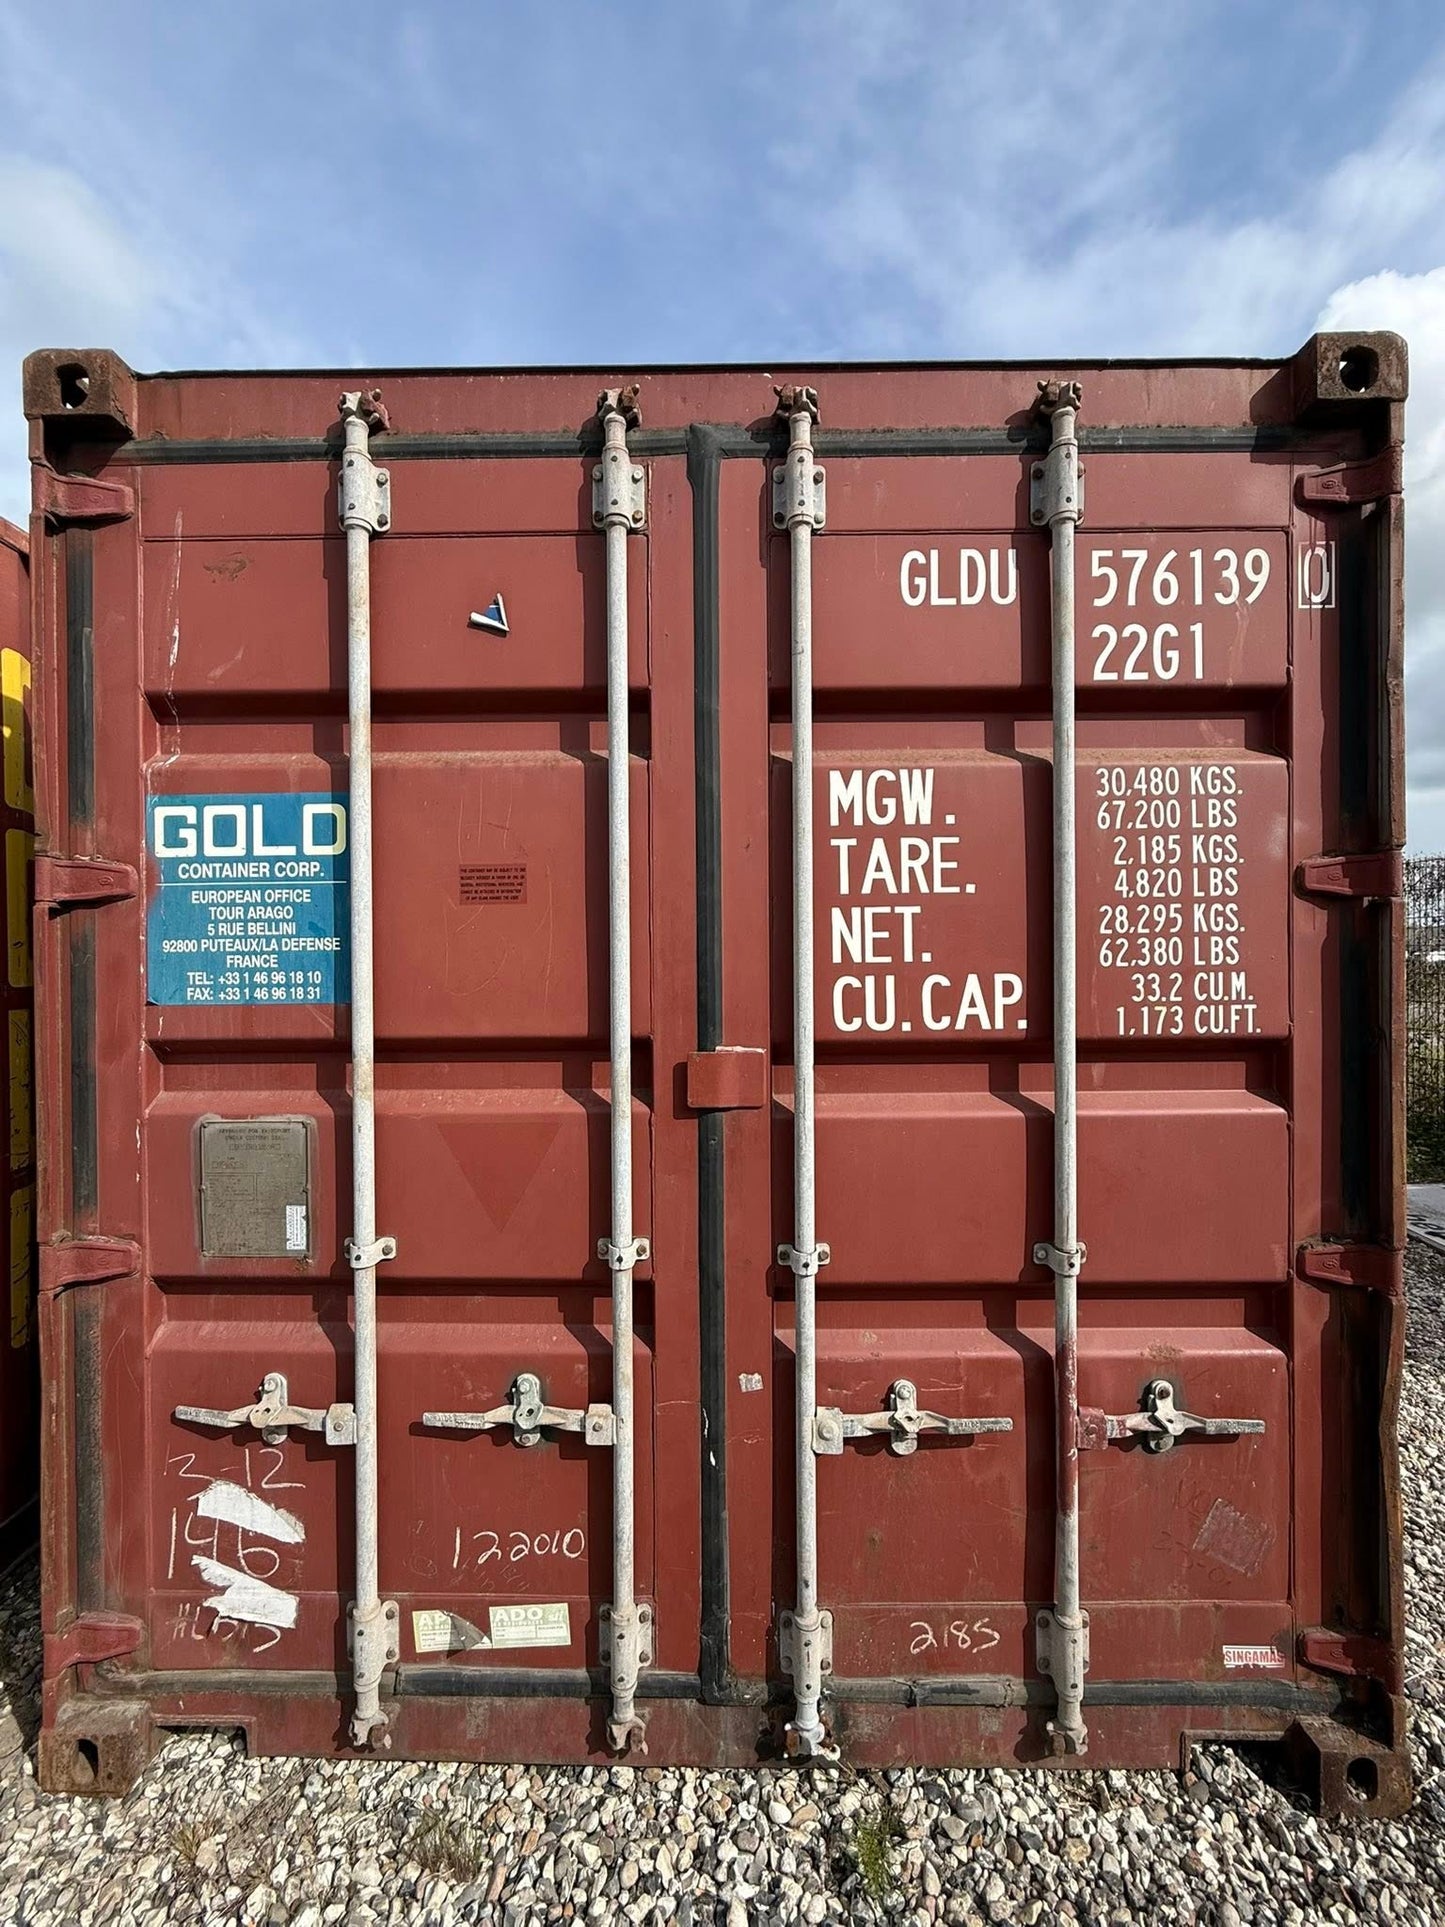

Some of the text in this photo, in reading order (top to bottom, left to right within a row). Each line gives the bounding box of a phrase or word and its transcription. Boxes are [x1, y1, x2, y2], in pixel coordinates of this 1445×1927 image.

[901, 549, 1016, 606] GLDU
[1092, 549, 1269, 606] 576139
[1092, 623, 1202, 680] 22G1
[1096, 766, 1242, 797] 30,480 KGS.
[830, 769, 955, 826] MGW.
[1098, 799, 1237, 829] 67,200 LBS
[154, 803, 347, 857] GOLD
[1114, 834, 1244, 865] 2,185 KGS.
[178, 862, 324, 878] CONTAINER CORP.
[831, 837, 975, 894] TARE.
[192, 889, 311, 903] EUROPEAN OFFICE
[1115, 868, 1238, 898] 4,820 LBS
[209, 906, 293, 919] TOUR ARAGO
[1100, 903, 1245, 934] 28,295 KGS.
[208, 922, 296, 936] 5 RUE BELLINI
[832, 907, 931, 963] NET.
[162, 938, 340, 952] 92800 PUTEAUX/LA DEFENSE
[1100, 936, 1239, 967] 62,380 LBS
[226, 955, 278, 967] FRANCE
[187, 971, 321, 985] TEL: +33 1 46 96 18 10
[1132, 973, 1182, 1002] 33.2
[187, 987, 321, 1000] FAX: +33 1 46 96 18 31
[1117, 1006, 1183, 1036] 1,173
[1225, 1650, 1287, 1663] SINGAMAS
